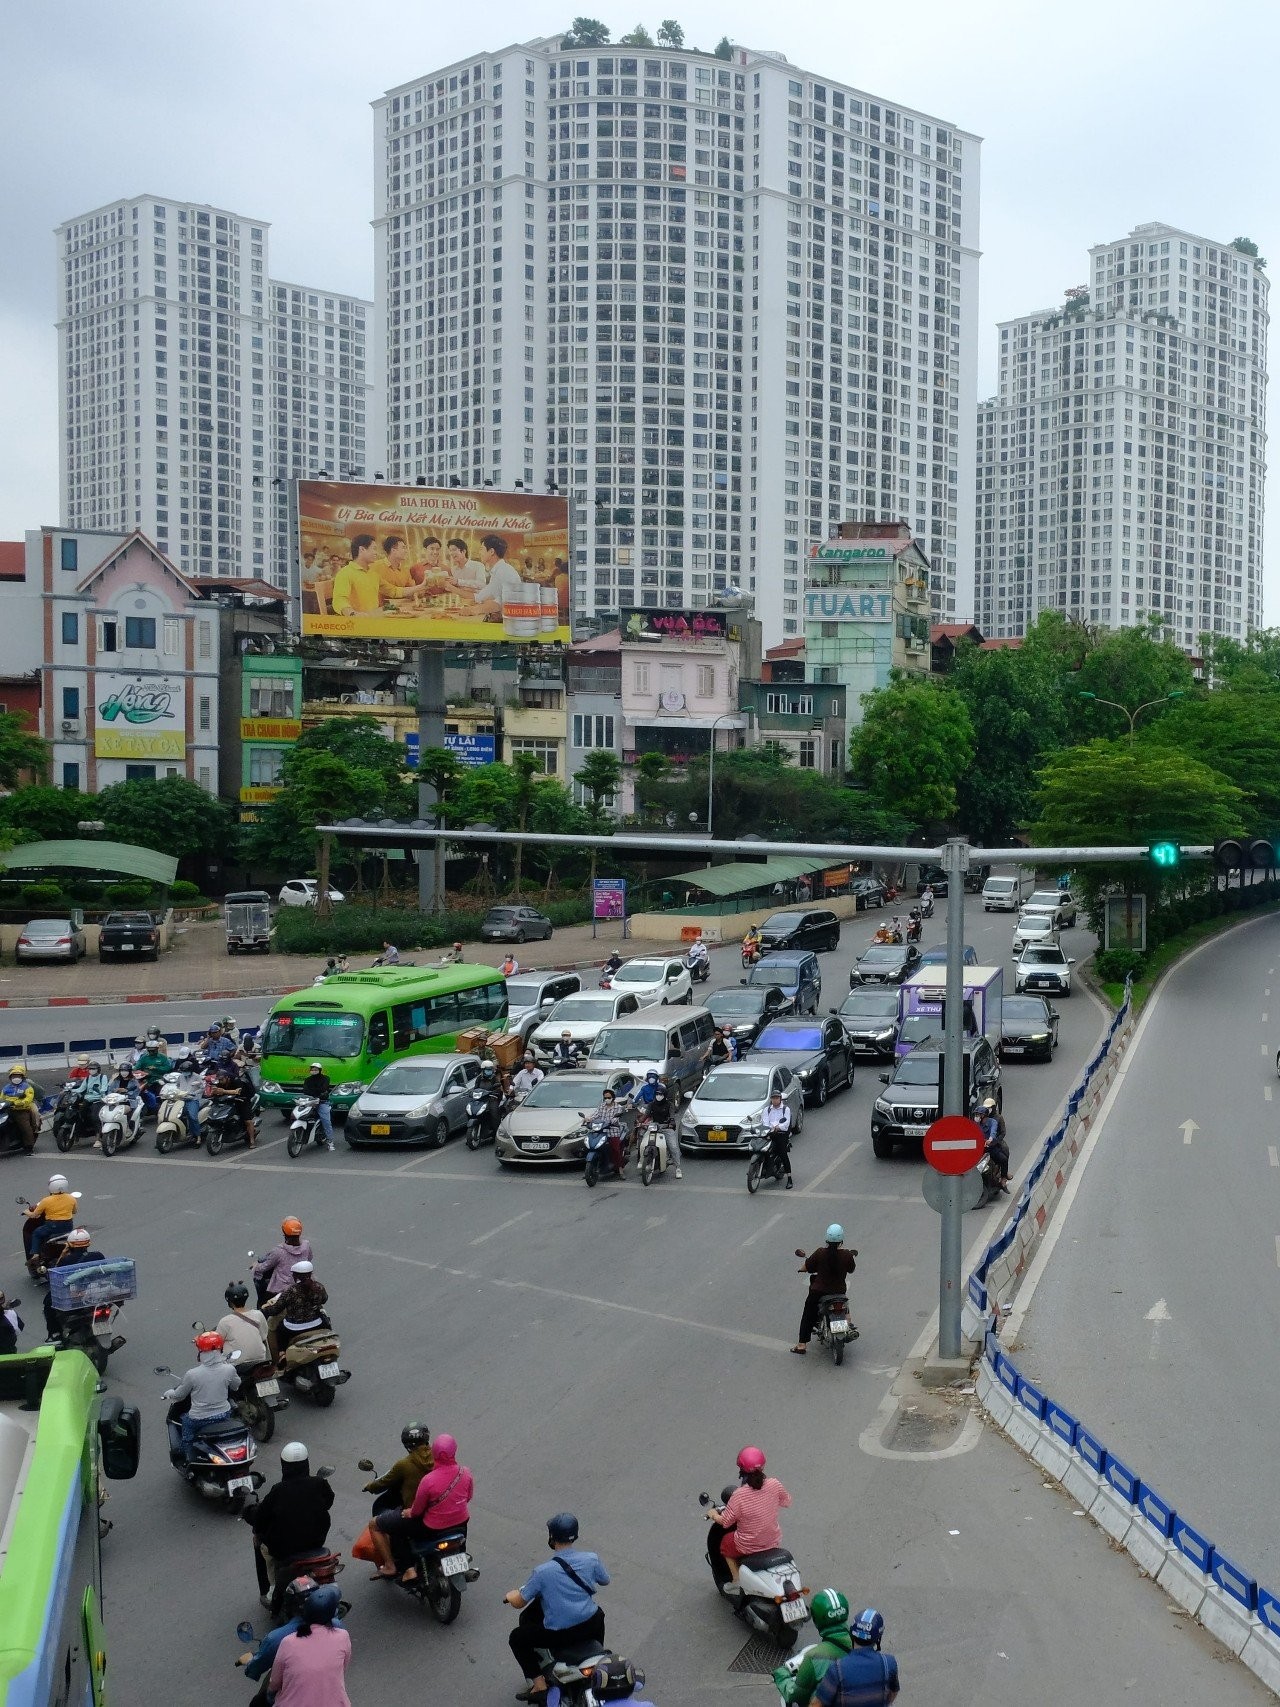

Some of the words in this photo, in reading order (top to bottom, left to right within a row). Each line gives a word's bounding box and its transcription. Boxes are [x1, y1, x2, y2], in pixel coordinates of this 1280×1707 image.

[400, 497, 418, 508] BIA
[420, 498, 439, 509] HƠI
[442, 497, 457, 510] HÀ
[458, 500, 477, 512] NỘI
[338, 508, 350, 521] Vị
[354, 510, 374, 521] Bia
[379, 509, 402, 522] Gắn
[406, 511, 428, 524] Kết
[431, 513, 451, 526] Mọi
[454, 513, 499, 528] Khoảnh
[502, 515, 531, 530] Khắc
[819, 544, 886, 561] Kangaroo
[805, 594, 891, 616] TUART
[310, 622, 346, 631] HABECO
[828, 1607, 846, 1618] Grab
